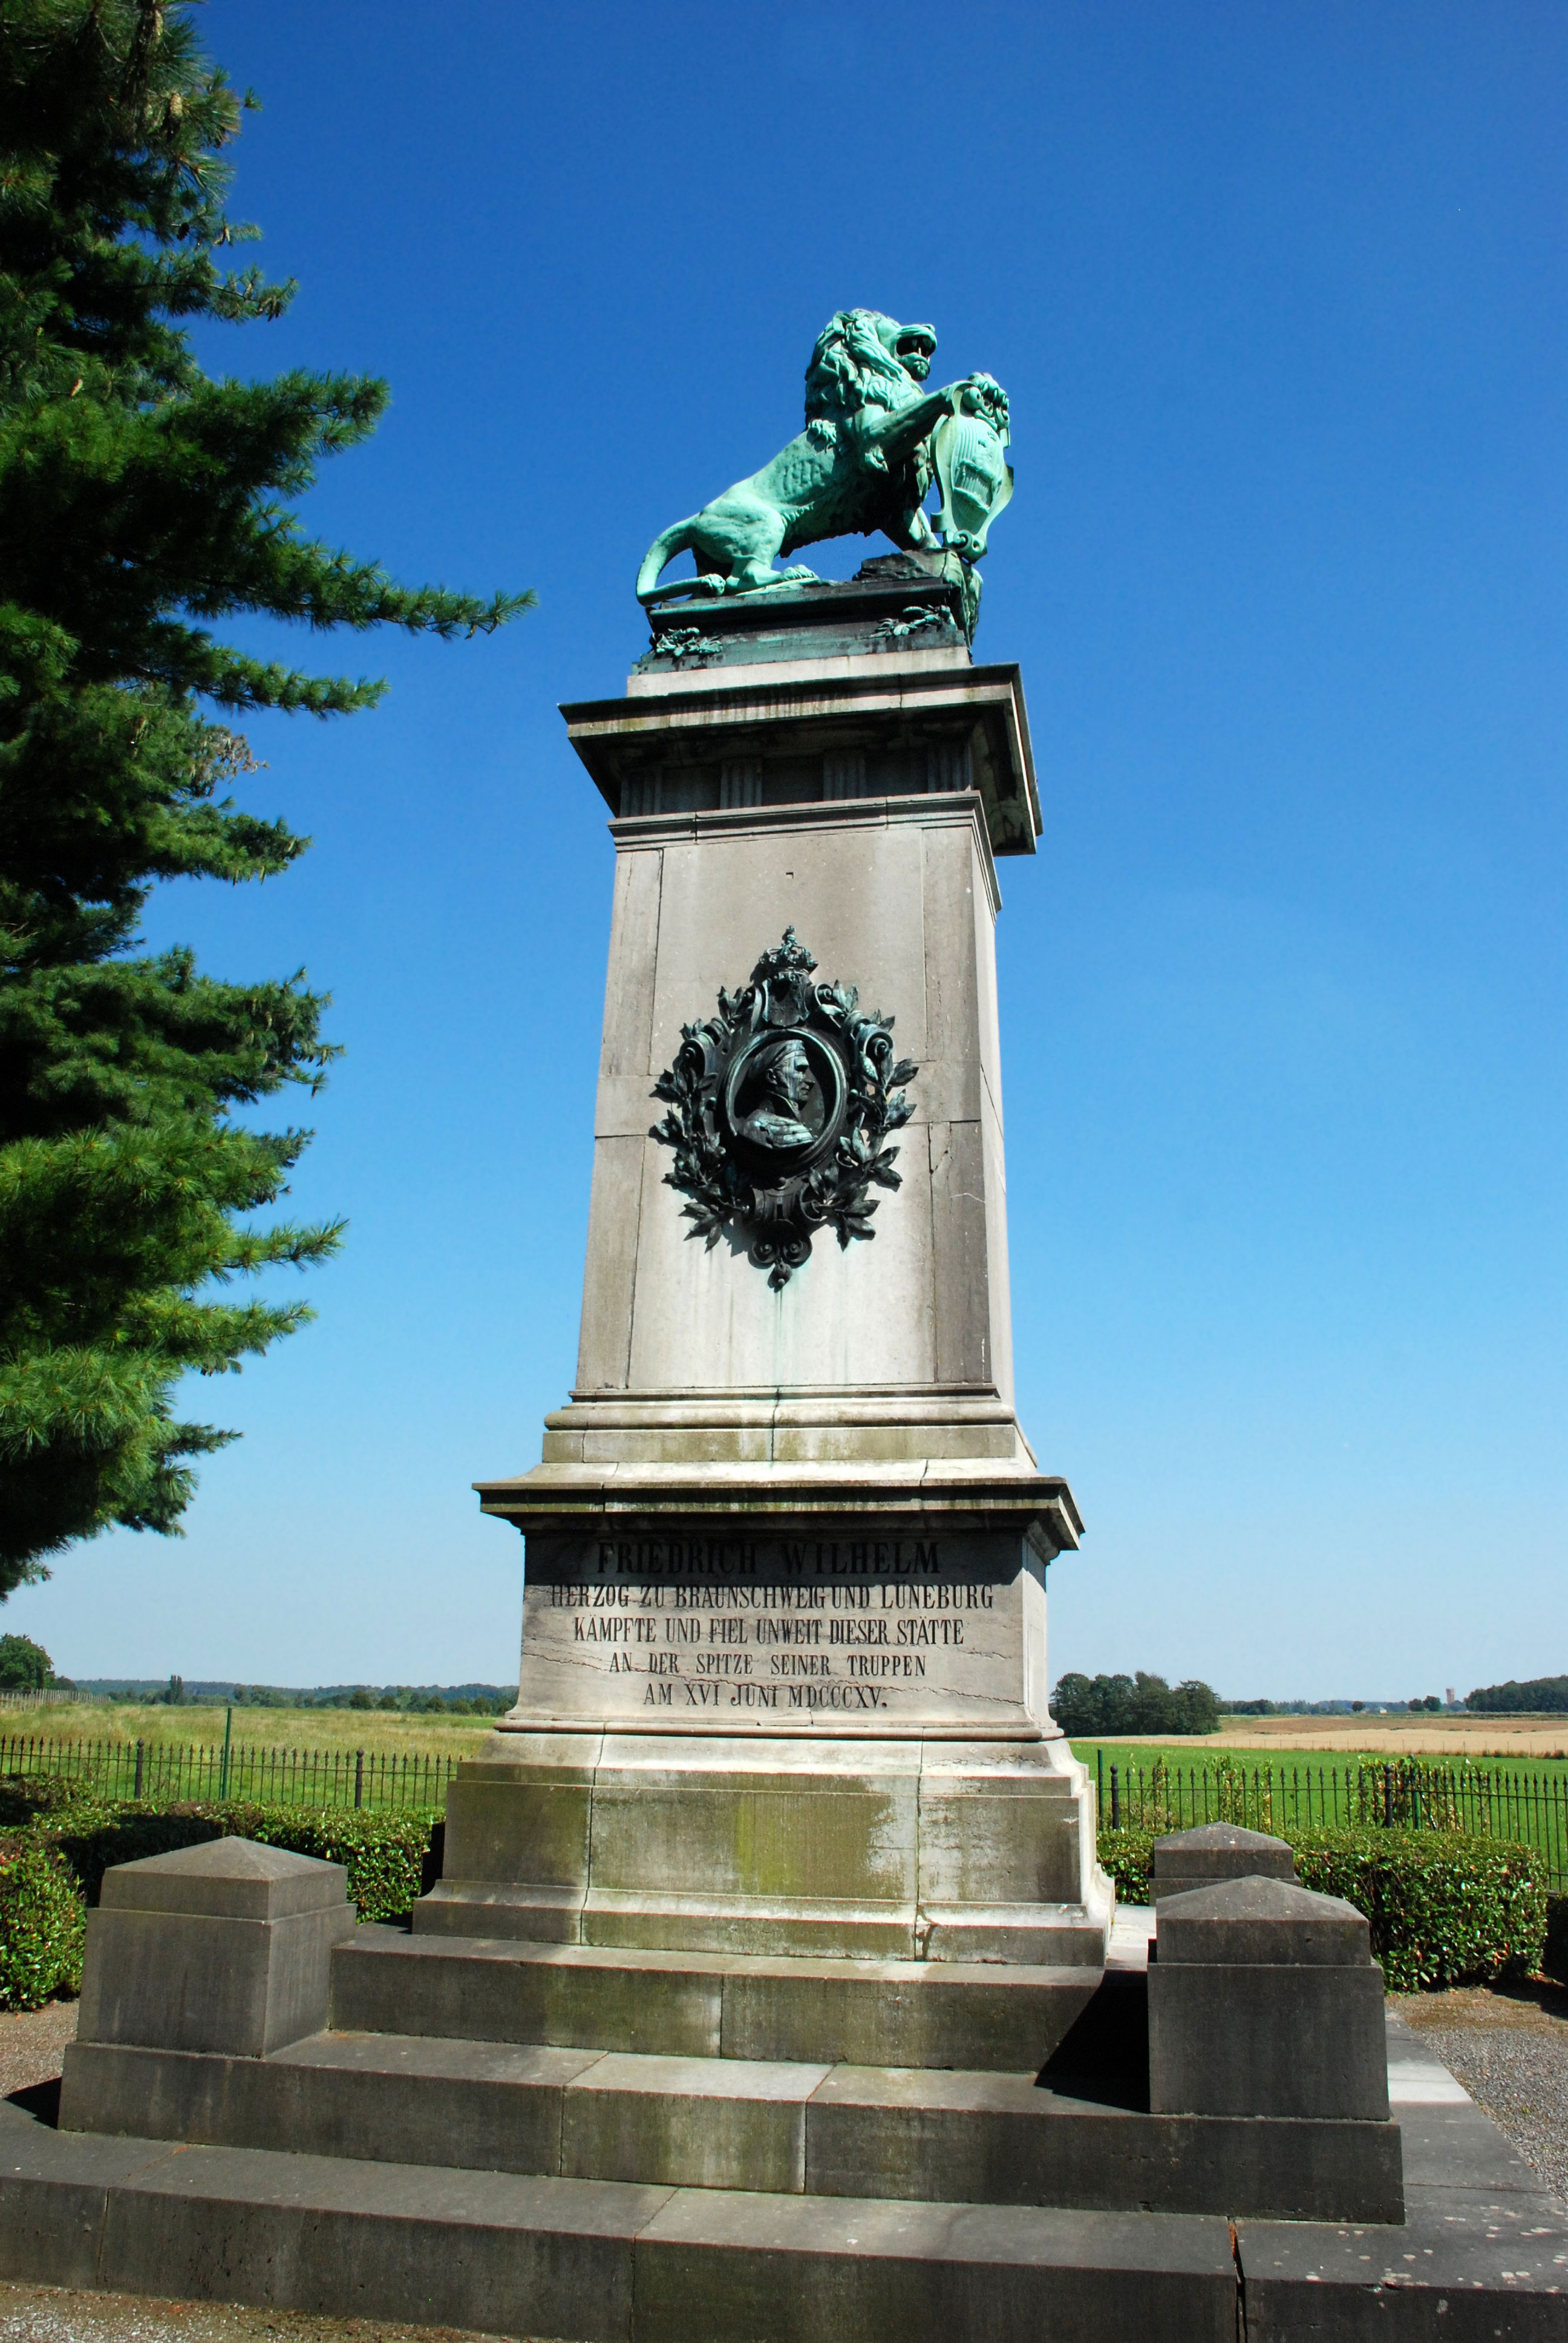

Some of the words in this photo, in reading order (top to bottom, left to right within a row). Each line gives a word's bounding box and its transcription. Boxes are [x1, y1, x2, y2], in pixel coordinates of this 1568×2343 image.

[598, 1542, 757, 1573] FRIEDRICH
[784, 1542, 940, 1574] WILHELM
[552, 1584, 629, 1607] HERZOG
[639, 1585, 664, 1608] ZU
[675, 1585, 825, 1608] BRAUNSCHWEIG
[832, 1585, 869, 1608] UND
[882, 1580, 993, 1609] LÜNEBURG
[574, 1614, 656, 1642] KÄMPFTE
[665, 1618, 700, 1643] UND
[709, 1618, 748, 1643] FIEL
[757, 1619, 822, 1644] UNWEIT
[829, 1619, 889, 1645] DIESER
[897, 1616, 964, 1645] STÄTTE
[610, 1653, 632, 1673] AN
[648, 1653, 679, 1674] DER
[697, 1654, 753, 1674] SPITZE
[771, 1654, 831, 1676] SEINER
[847, 1655, 926, 1676] TRUPPEN
[644, 1683, 672, 1705] AM
[685, 1684, 719, 1706] XVI
[731, 1685, 778, 1707] JUNI
[789, 1686, 887, 1708] MDCCCXV.
